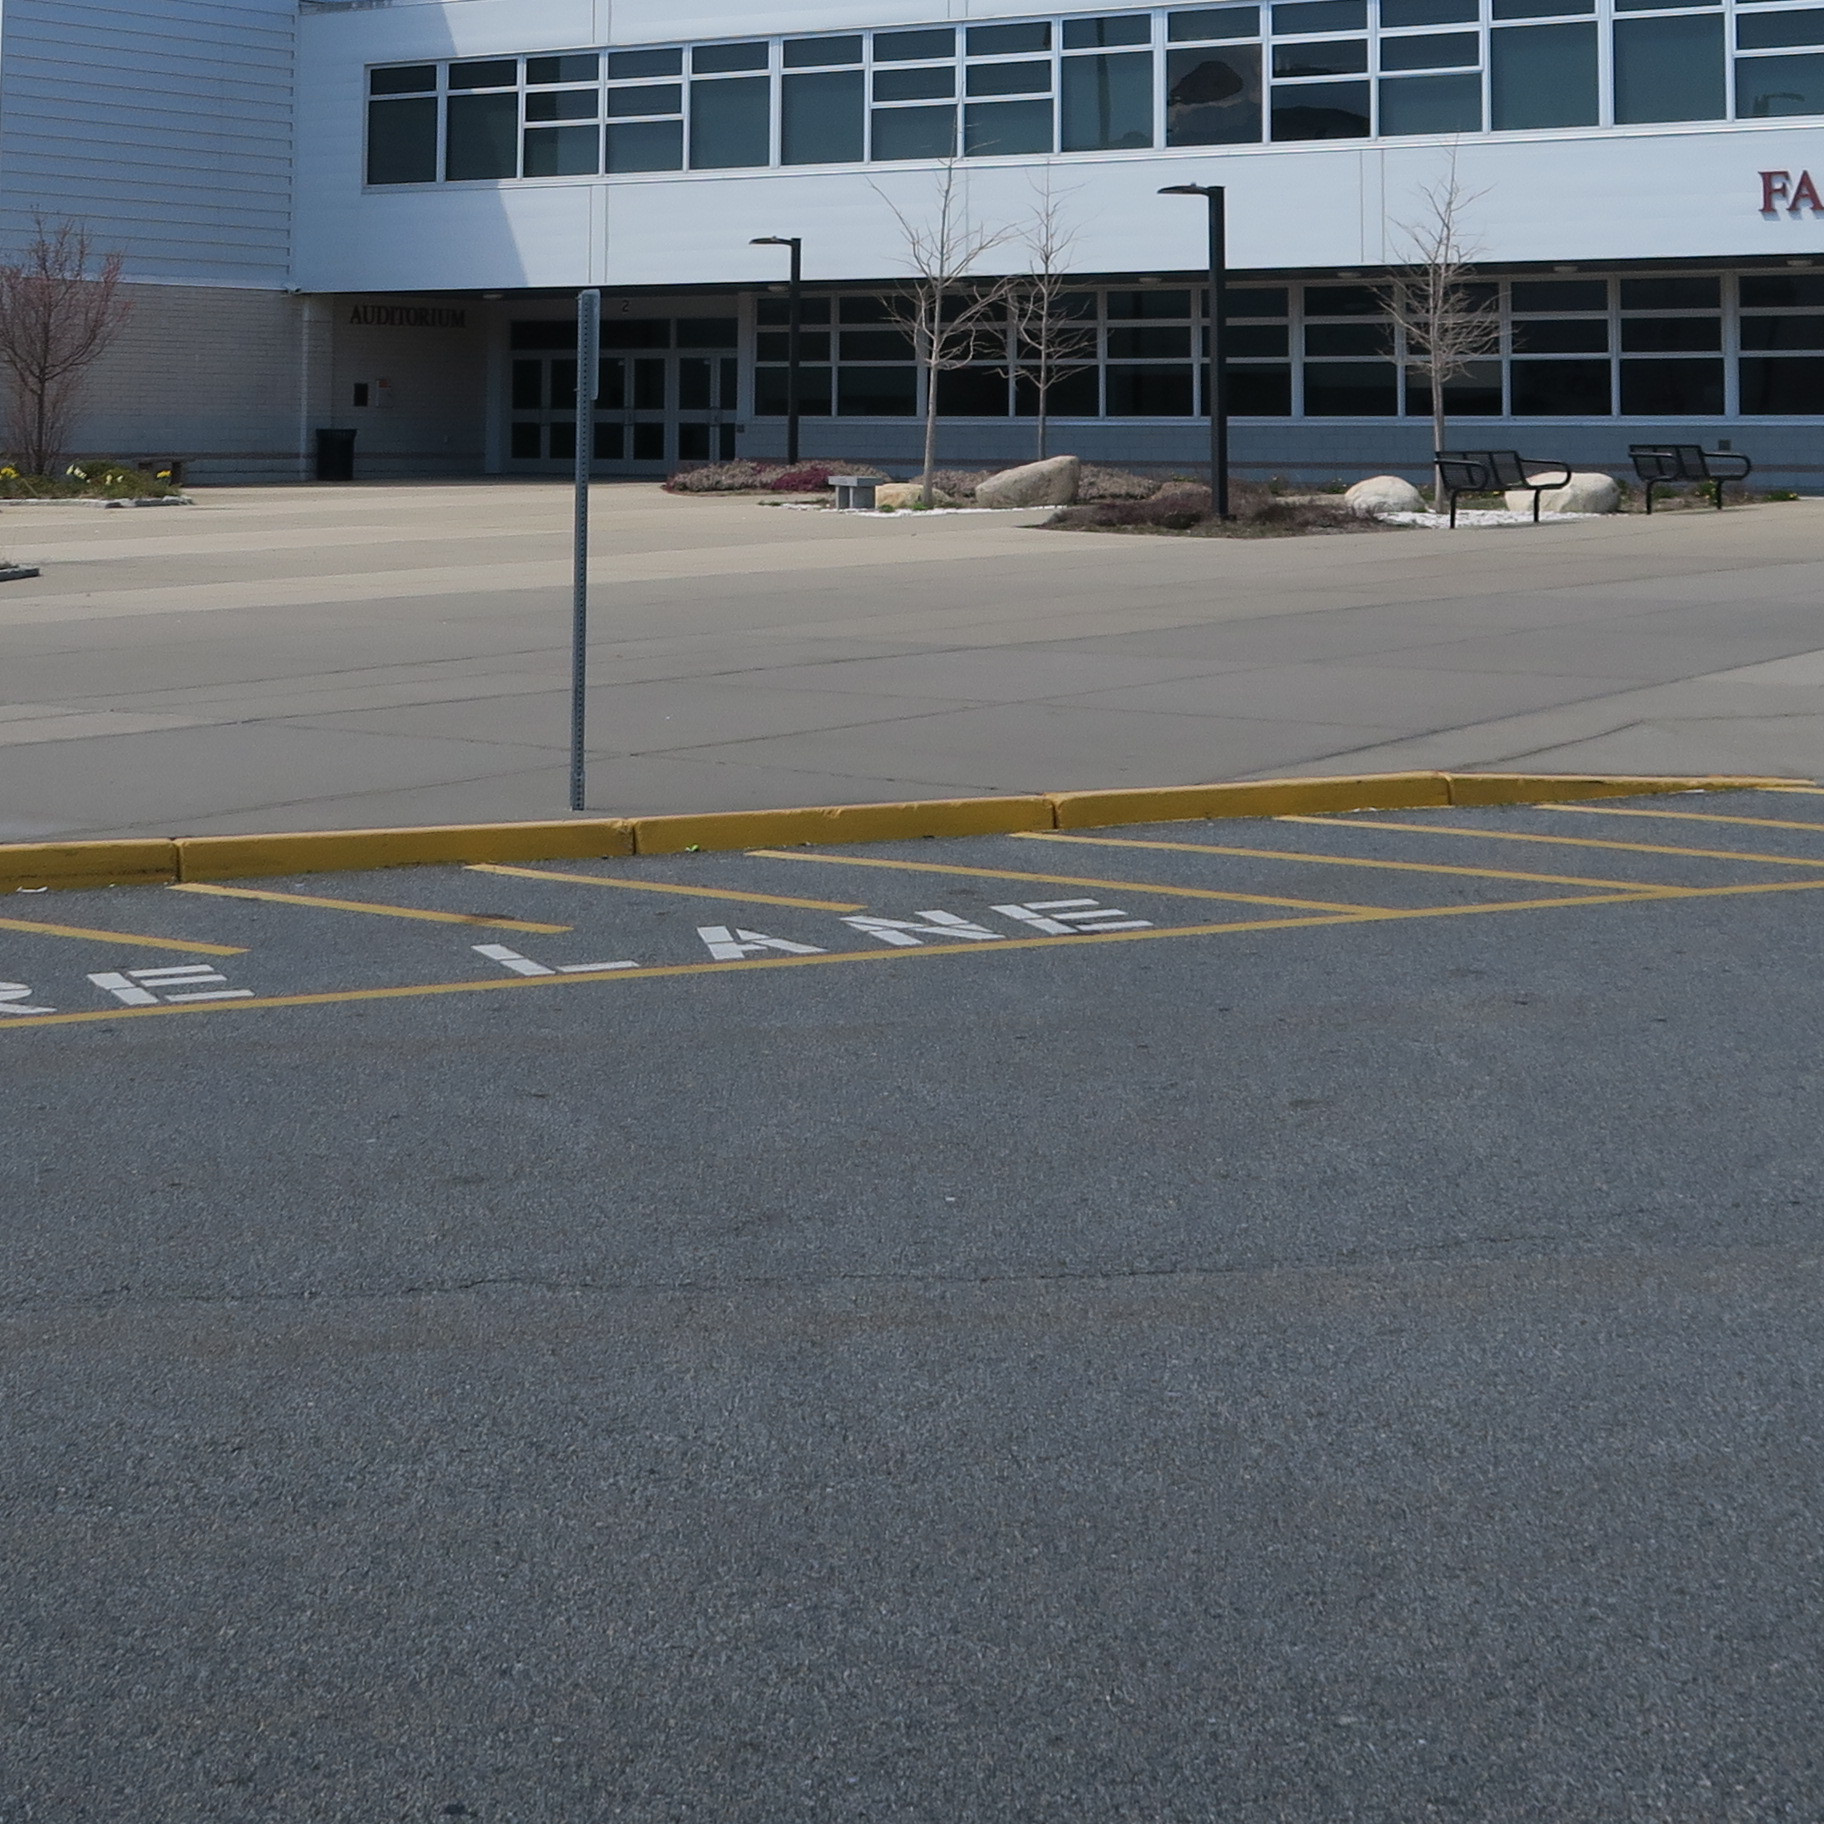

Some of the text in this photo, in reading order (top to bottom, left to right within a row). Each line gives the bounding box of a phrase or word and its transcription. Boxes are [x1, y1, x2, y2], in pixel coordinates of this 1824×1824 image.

[350, 303, 466, 328] AUDITORIUM
[621, 299, 630, 313] 2
[471, 897, 1155, 976] LANE
